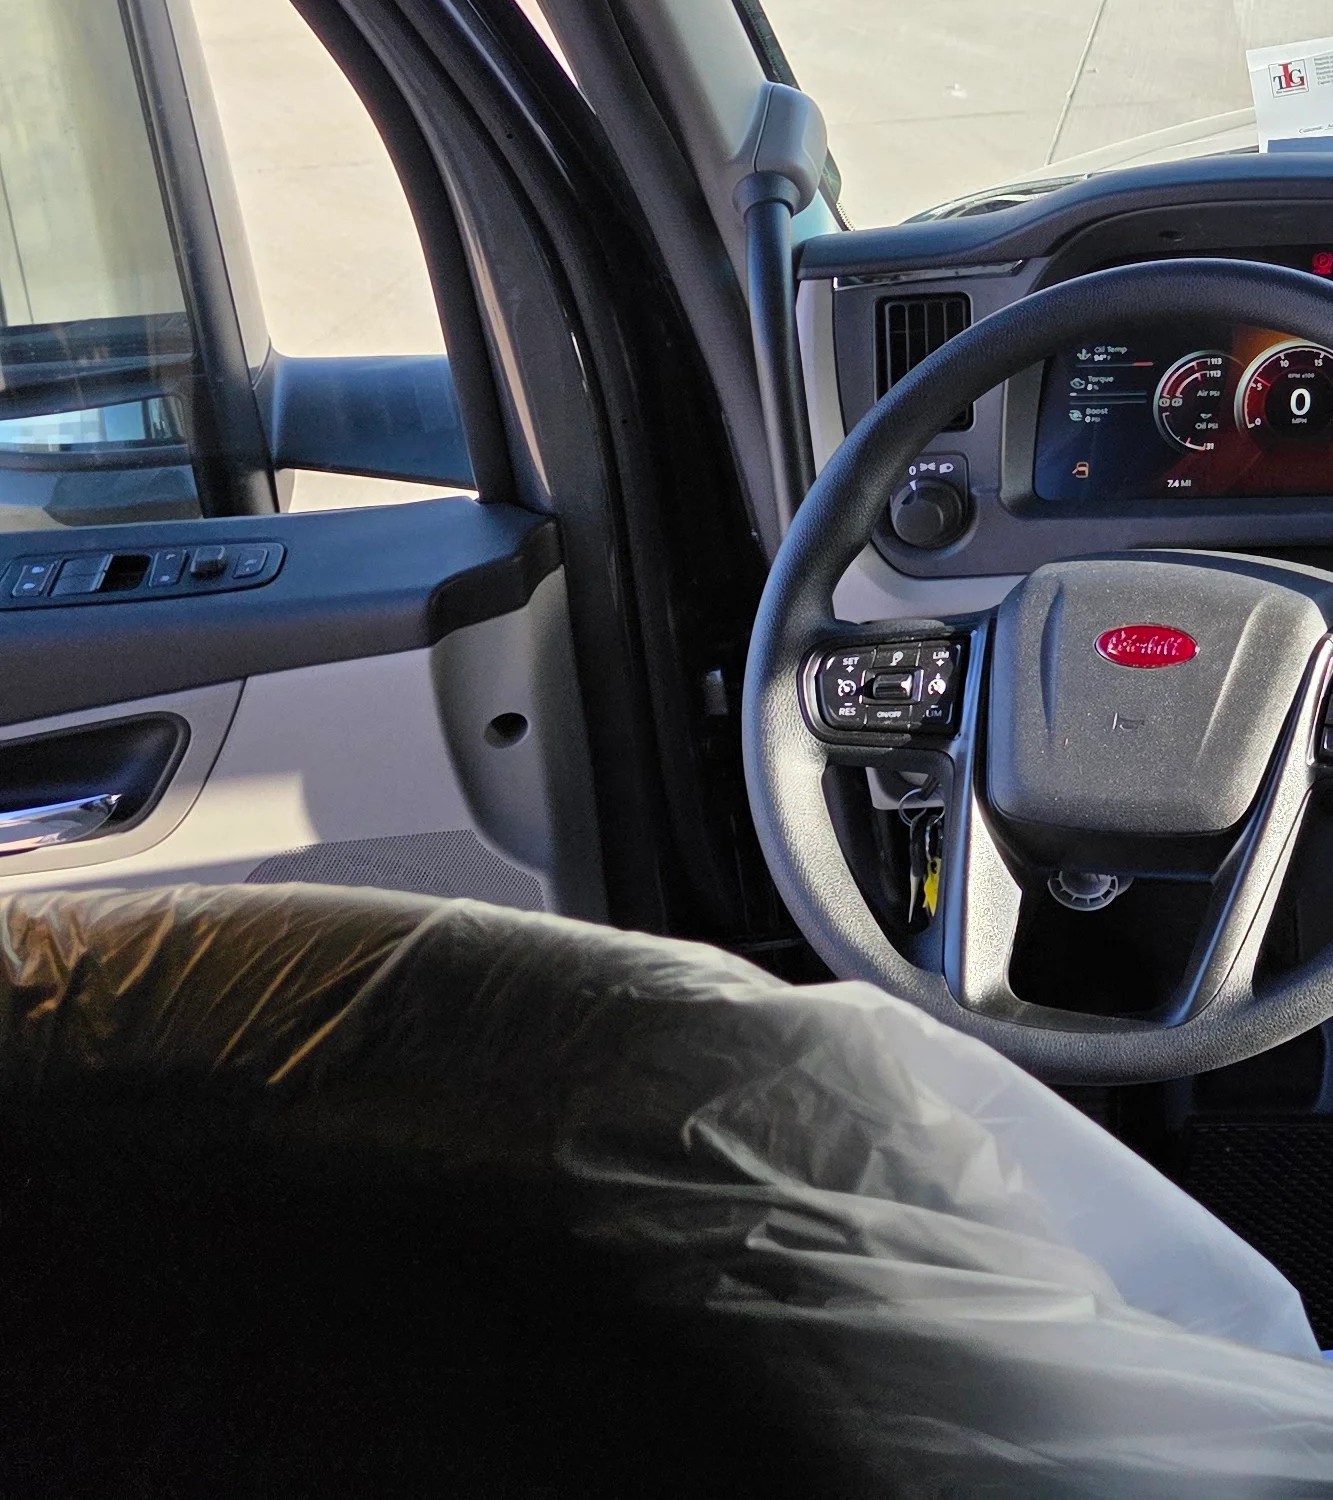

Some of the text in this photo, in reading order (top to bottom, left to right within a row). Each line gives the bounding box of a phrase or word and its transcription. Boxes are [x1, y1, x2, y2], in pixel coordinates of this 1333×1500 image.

[1273, 62, 1305, 90] TLG
[1107, 346, 1128, 354] Temp
[1290, 388, 1311, 416] 0
[1107, 631, 1183, 655] Peterbilt
[933, 651, 949, 660] LIM
[843, 657, 859, 666] SET
[839, 708, 856, 716] RES
